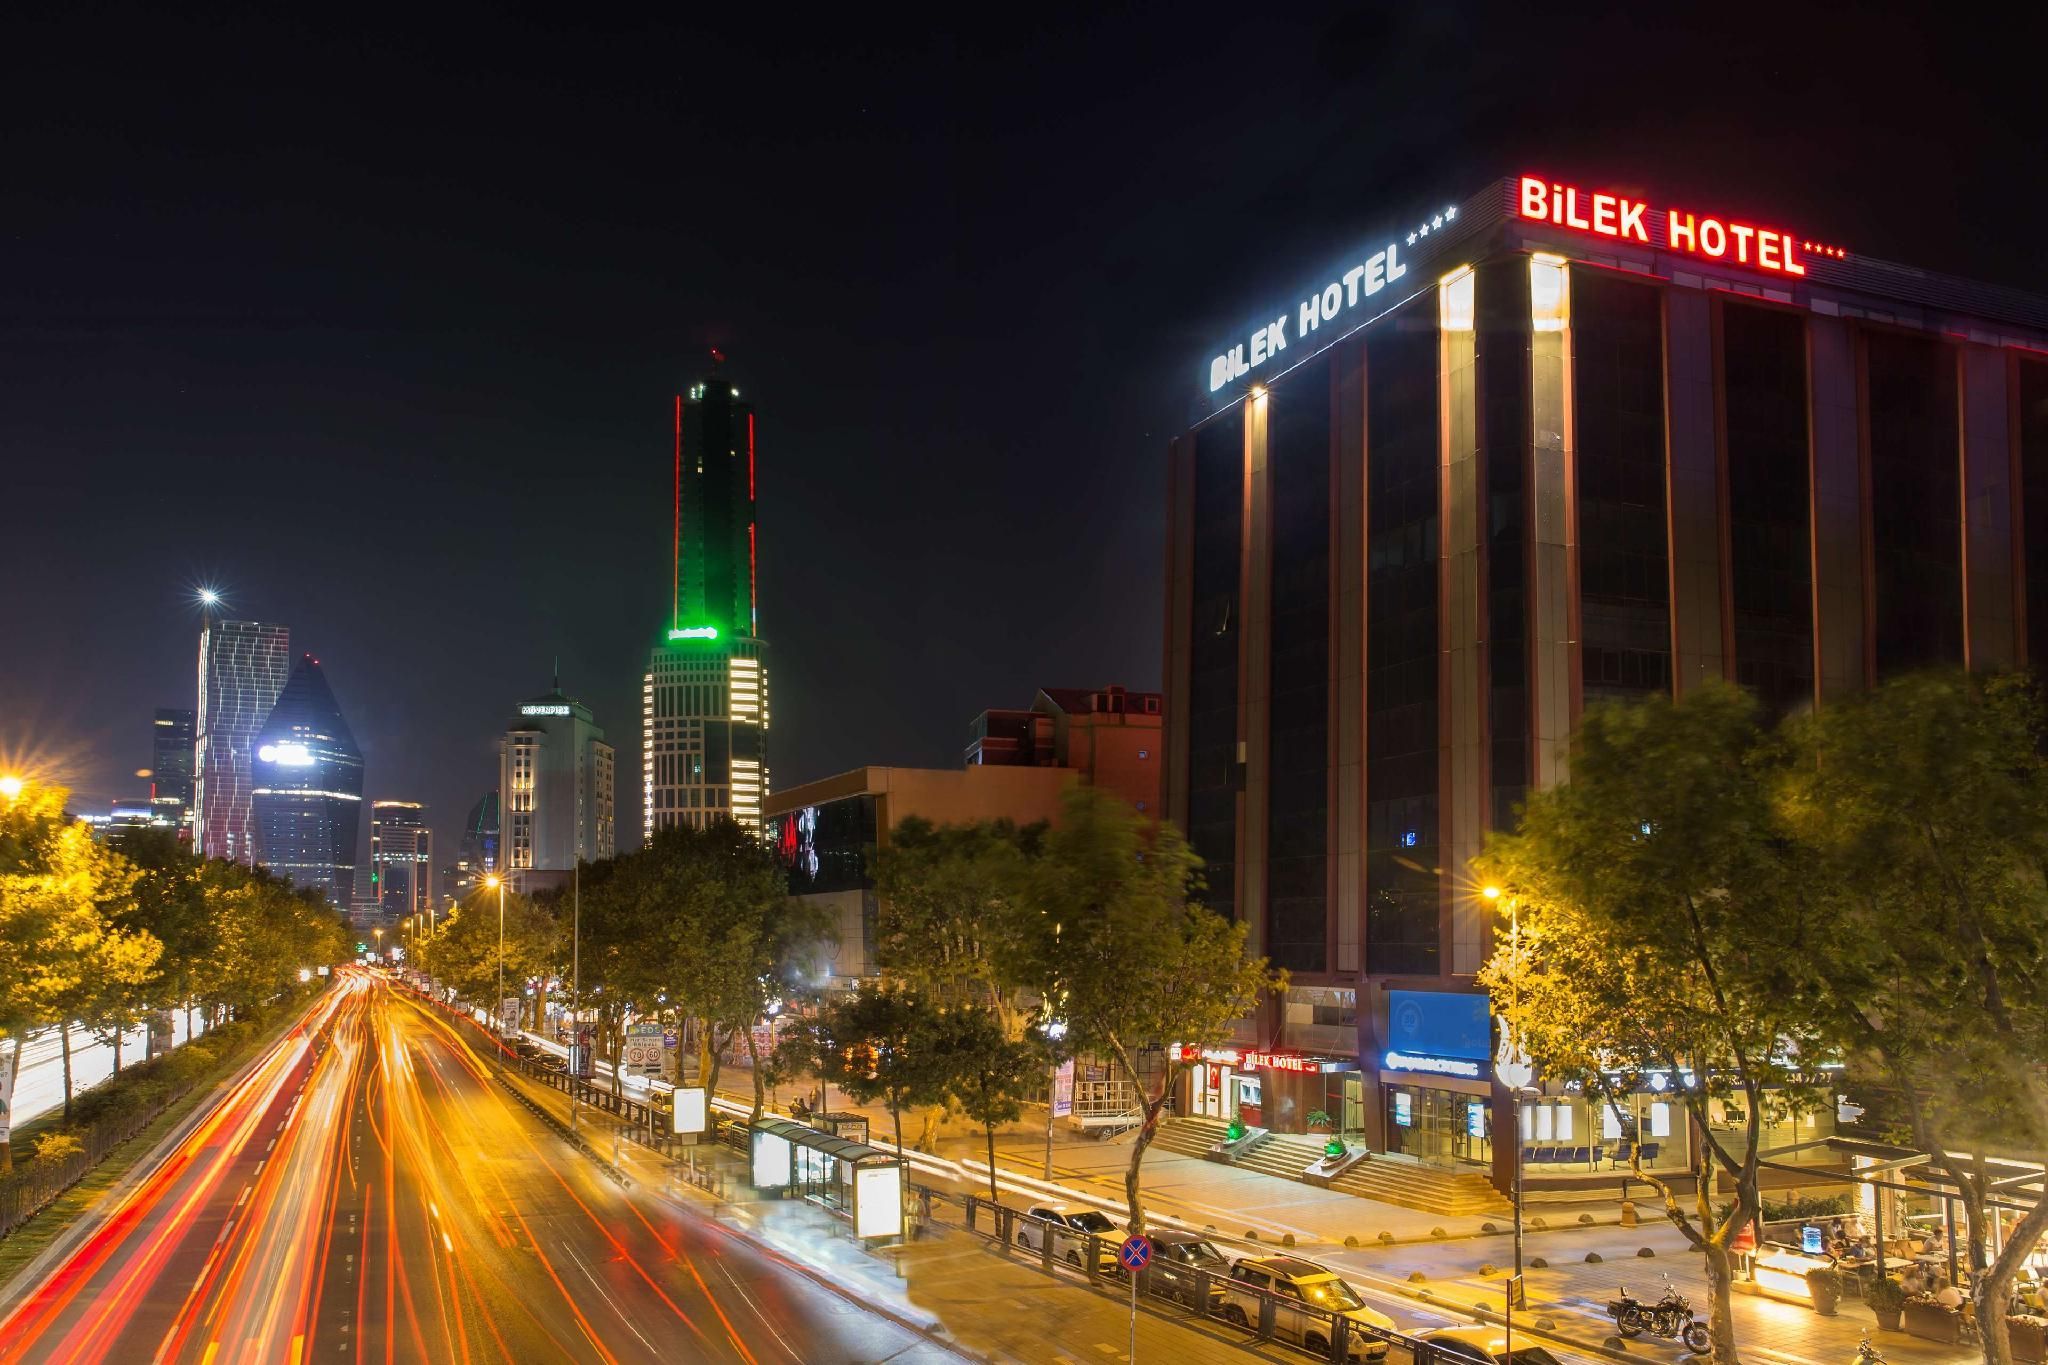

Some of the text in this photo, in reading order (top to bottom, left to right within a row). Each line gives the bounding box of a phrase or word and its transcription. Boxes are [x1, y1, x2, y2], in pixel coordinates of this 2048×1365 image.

[1668, 210, 1805, 275] HOTEL
[1299, 243, 1407, 338] HOTEL
[1273, 1056, 1303, 1071] HOTEL
